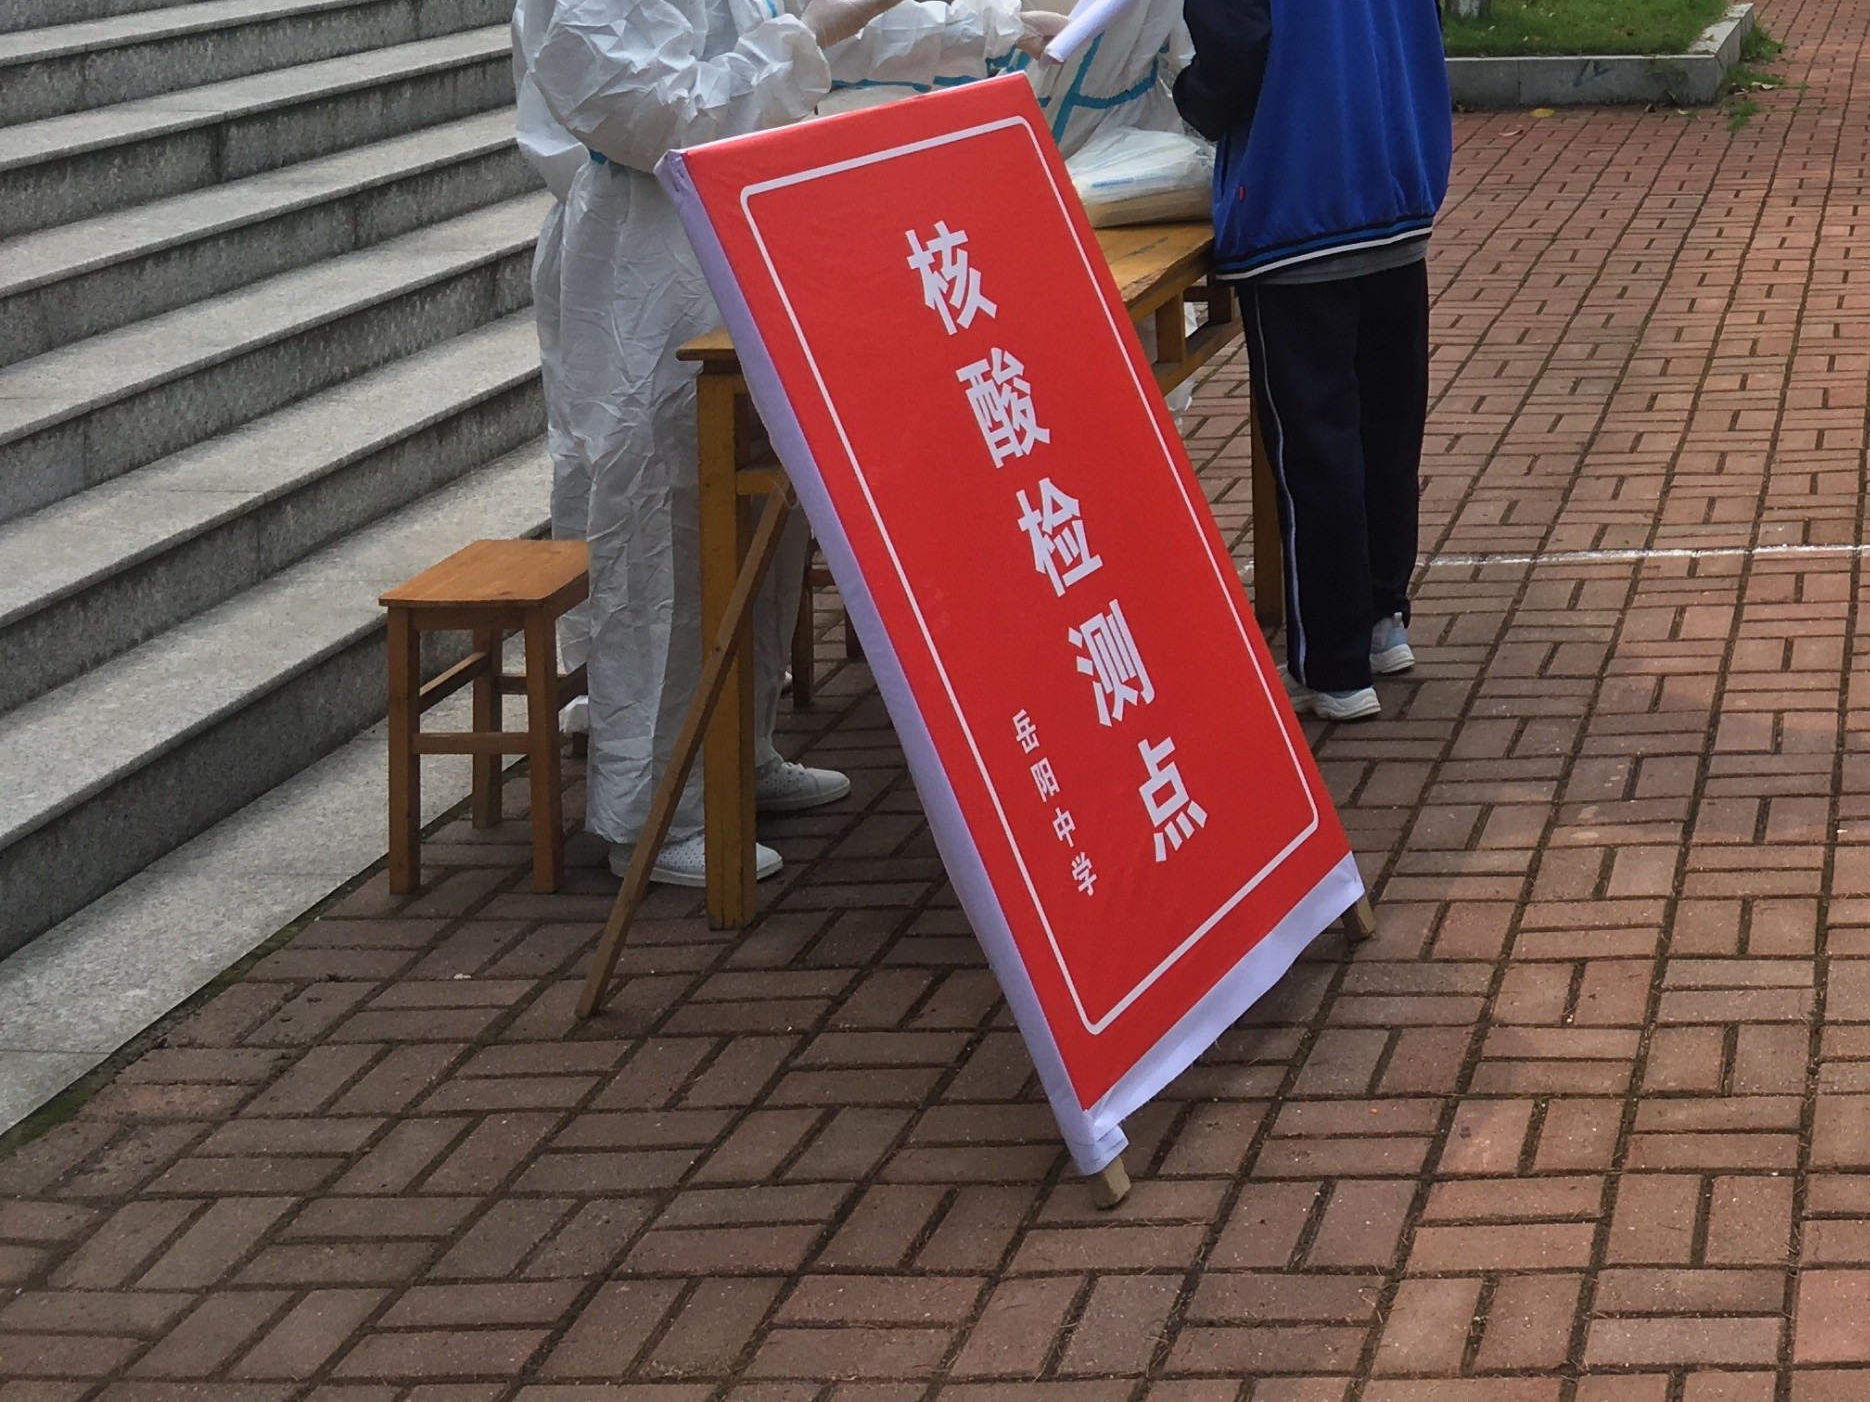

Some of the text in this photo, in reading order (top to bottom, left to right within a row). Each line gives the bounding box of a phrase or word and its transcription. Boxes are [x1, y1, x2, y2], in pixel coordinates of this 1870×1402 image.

[904, 220, 1208, 864] 核酸检测点
[1012, 708, 1098, 898] 岳阳中学
